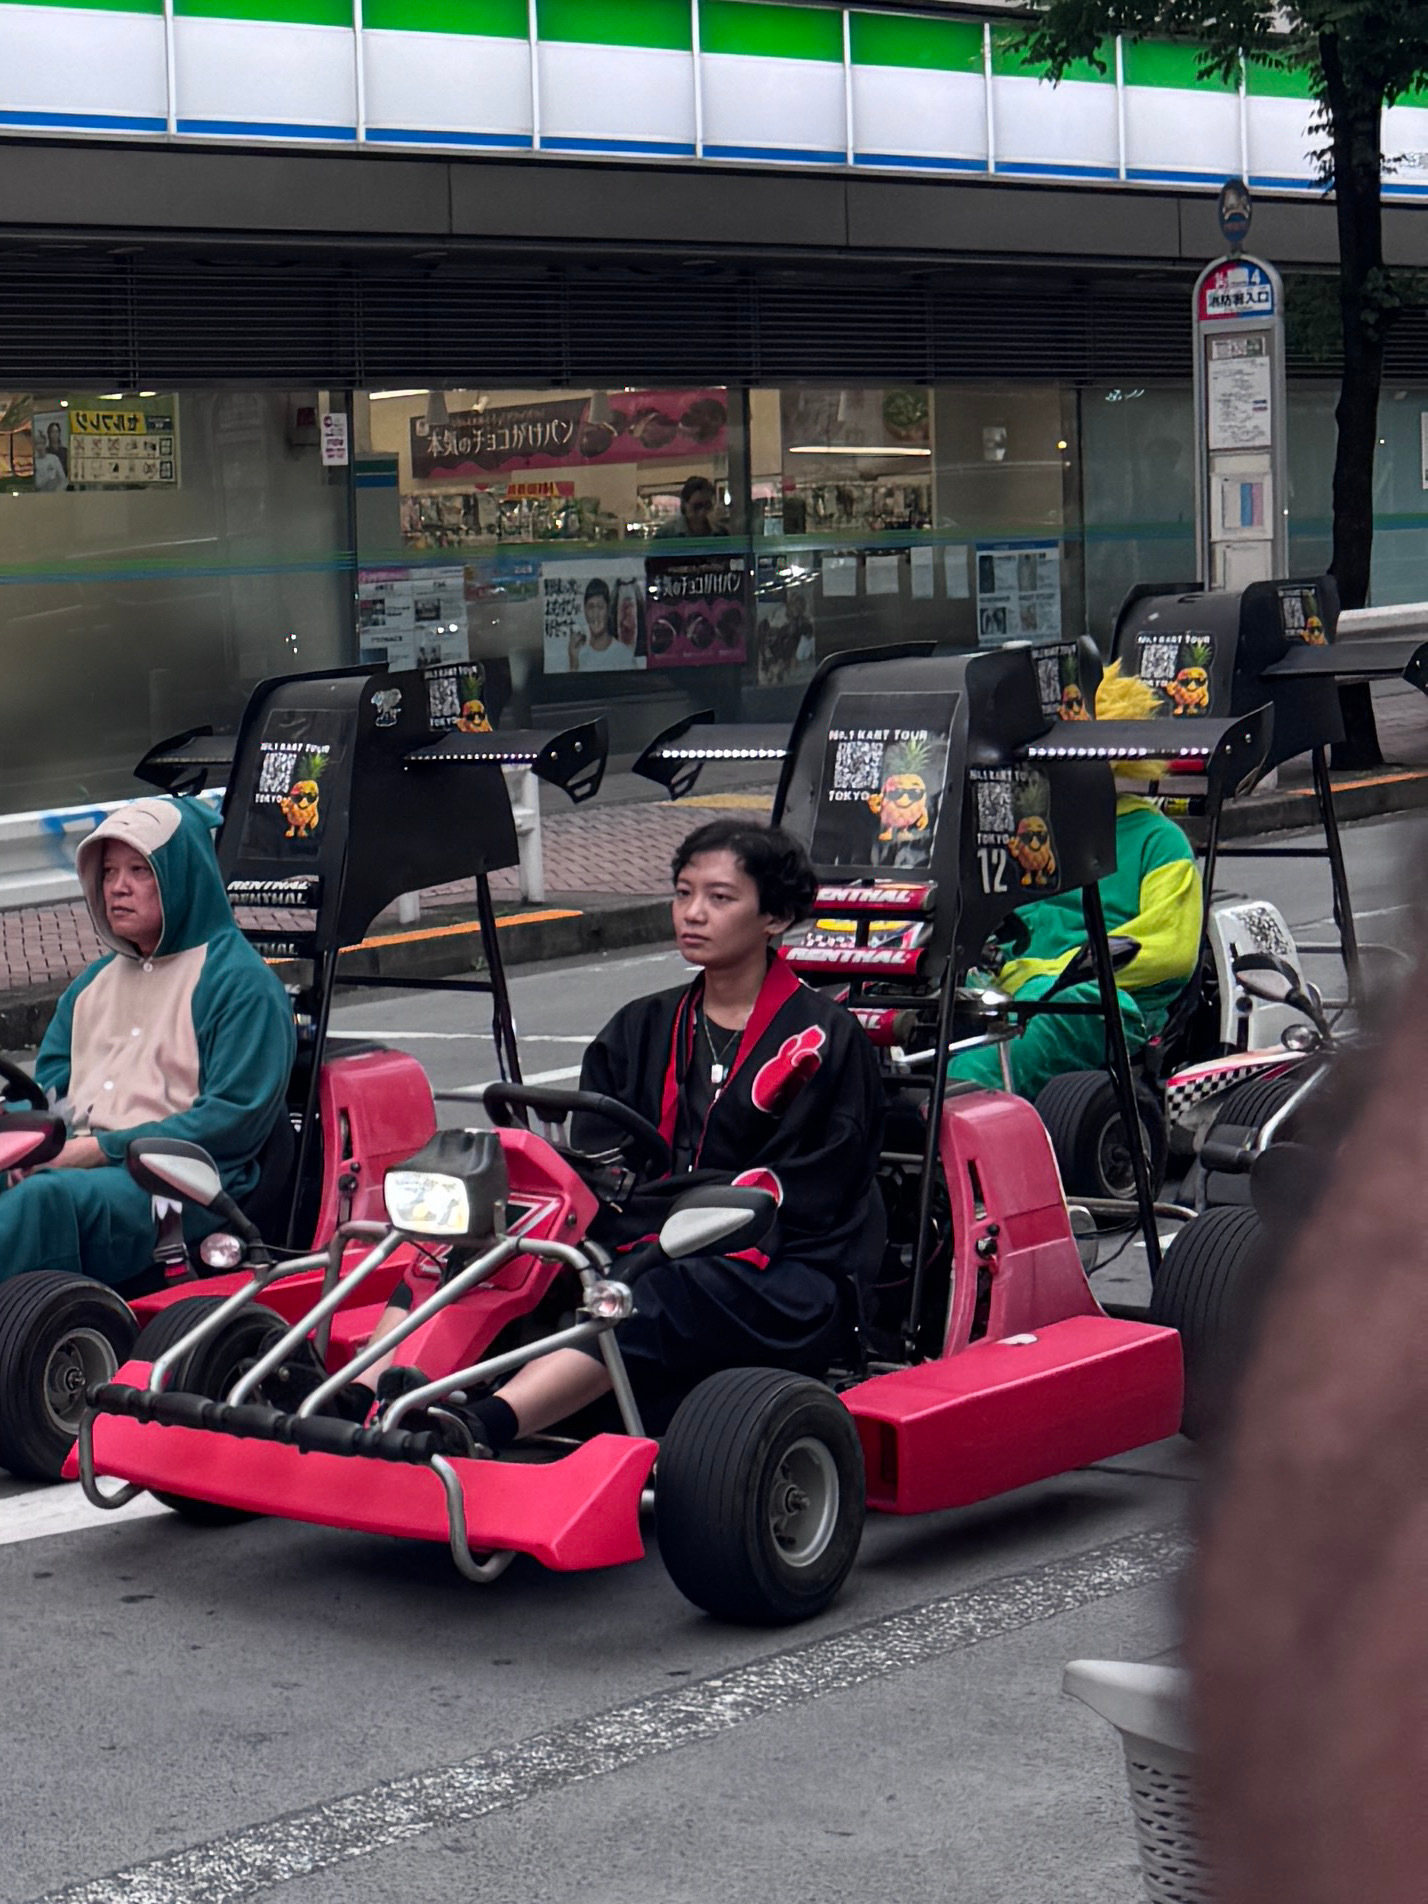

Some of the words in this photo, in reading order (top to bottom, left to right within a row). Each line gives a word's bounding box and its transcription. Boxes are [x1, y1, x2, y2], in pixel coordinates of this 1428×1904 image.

[427, 418, 574, 458] 本気のチョコがけパン
[857, 729, 891, 741] KART
[894, 729, 928, 741] TOUR
[828, 790, 870, 802] TOKYO
[976, 847, 1008, 894] 12
[815, 886, 914, 903] ENTHAL
[785, 947, 911, 964] RENTHAL
